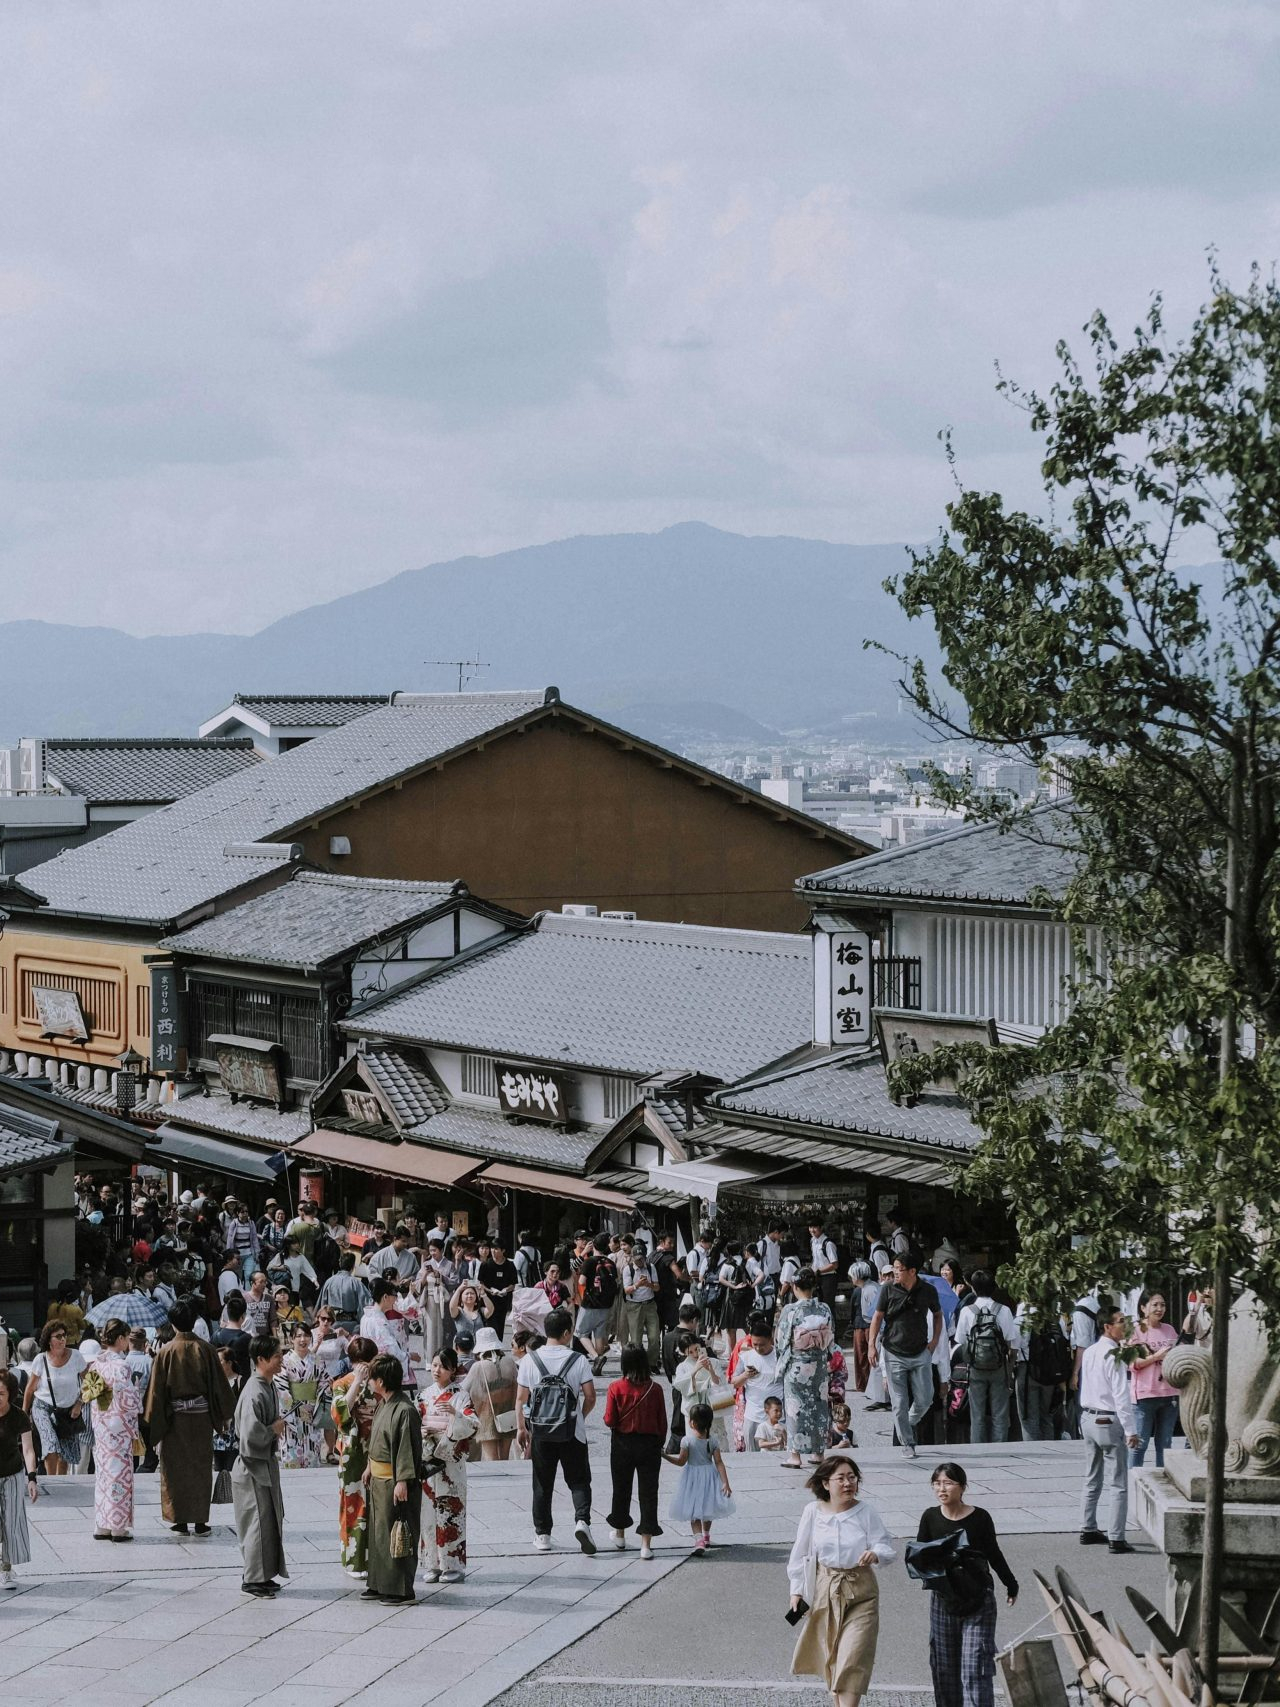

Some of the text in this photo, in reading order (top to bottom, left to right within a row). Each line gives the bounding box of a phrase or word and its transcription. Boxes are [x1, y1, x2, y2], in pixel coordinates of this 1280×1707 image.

[161, 975, 169, 1014] 京つけもの
[836, 941, 864, 1034] 梅山堂
[156, 1018, 174, 1062] 西利
